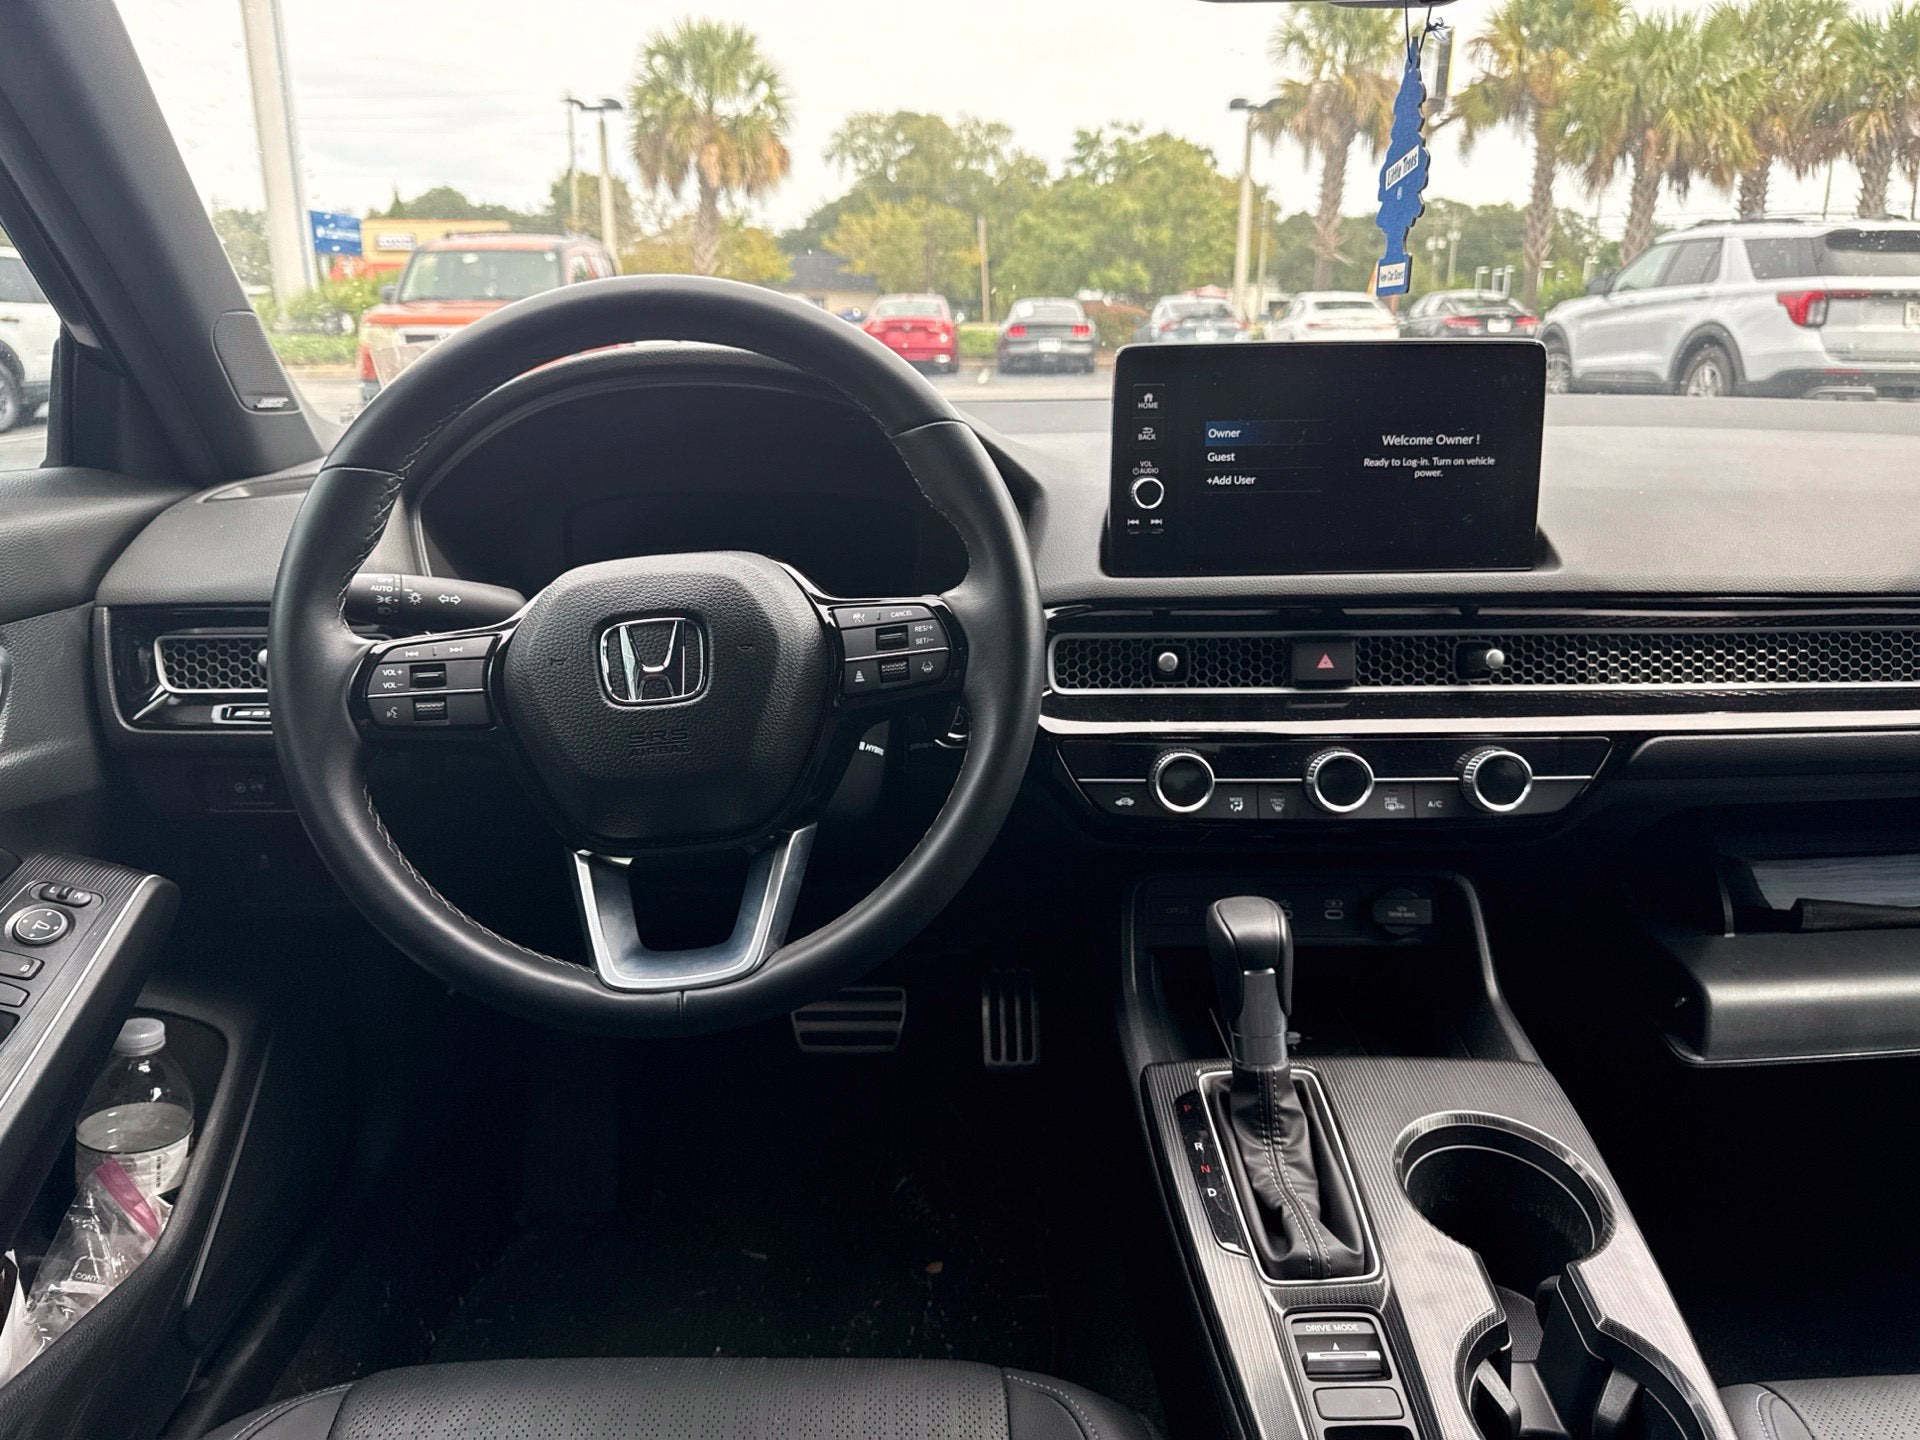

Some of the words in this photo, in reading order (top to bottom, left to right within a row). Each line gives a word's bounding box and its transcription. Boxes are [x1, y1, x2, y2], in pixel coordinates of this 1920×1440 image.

[1403, 153, 1417, 176] Trees
[1208, 428, 1241, 438] Owner
[1382, 434, 1433, 446] Welcome
[1435, 434, 1474, 445] Owner
[1207, 452, 1236, 462] Guest
[1363, 457, 1390, 468] Ready
[1391, 458, 1401, 467] to
[1402, 457, 1430, 468] Log-in.
[1432, 456, 1452, 466] Turn
[1453, 458, 1465, 466] on
[1466, 456, 1495, 466] vehicle
[1414, 469, 1443, 479] power.
[1234, 475, 1256, 485] User
[890, 610, 913, 618] CANCEL
[1428, 800, 1443, 808] A/C
[1183, 1104, 1191, 1112] P
[1194, 1142, 1204, 1151] R
[1200, 1164, 1211, 1173] N
[1207, 1187, 1217, 1197] D
[1305, 1324, 1332, 1332] DRIVE
[1333, 1323, 1359, 1331] MODE
